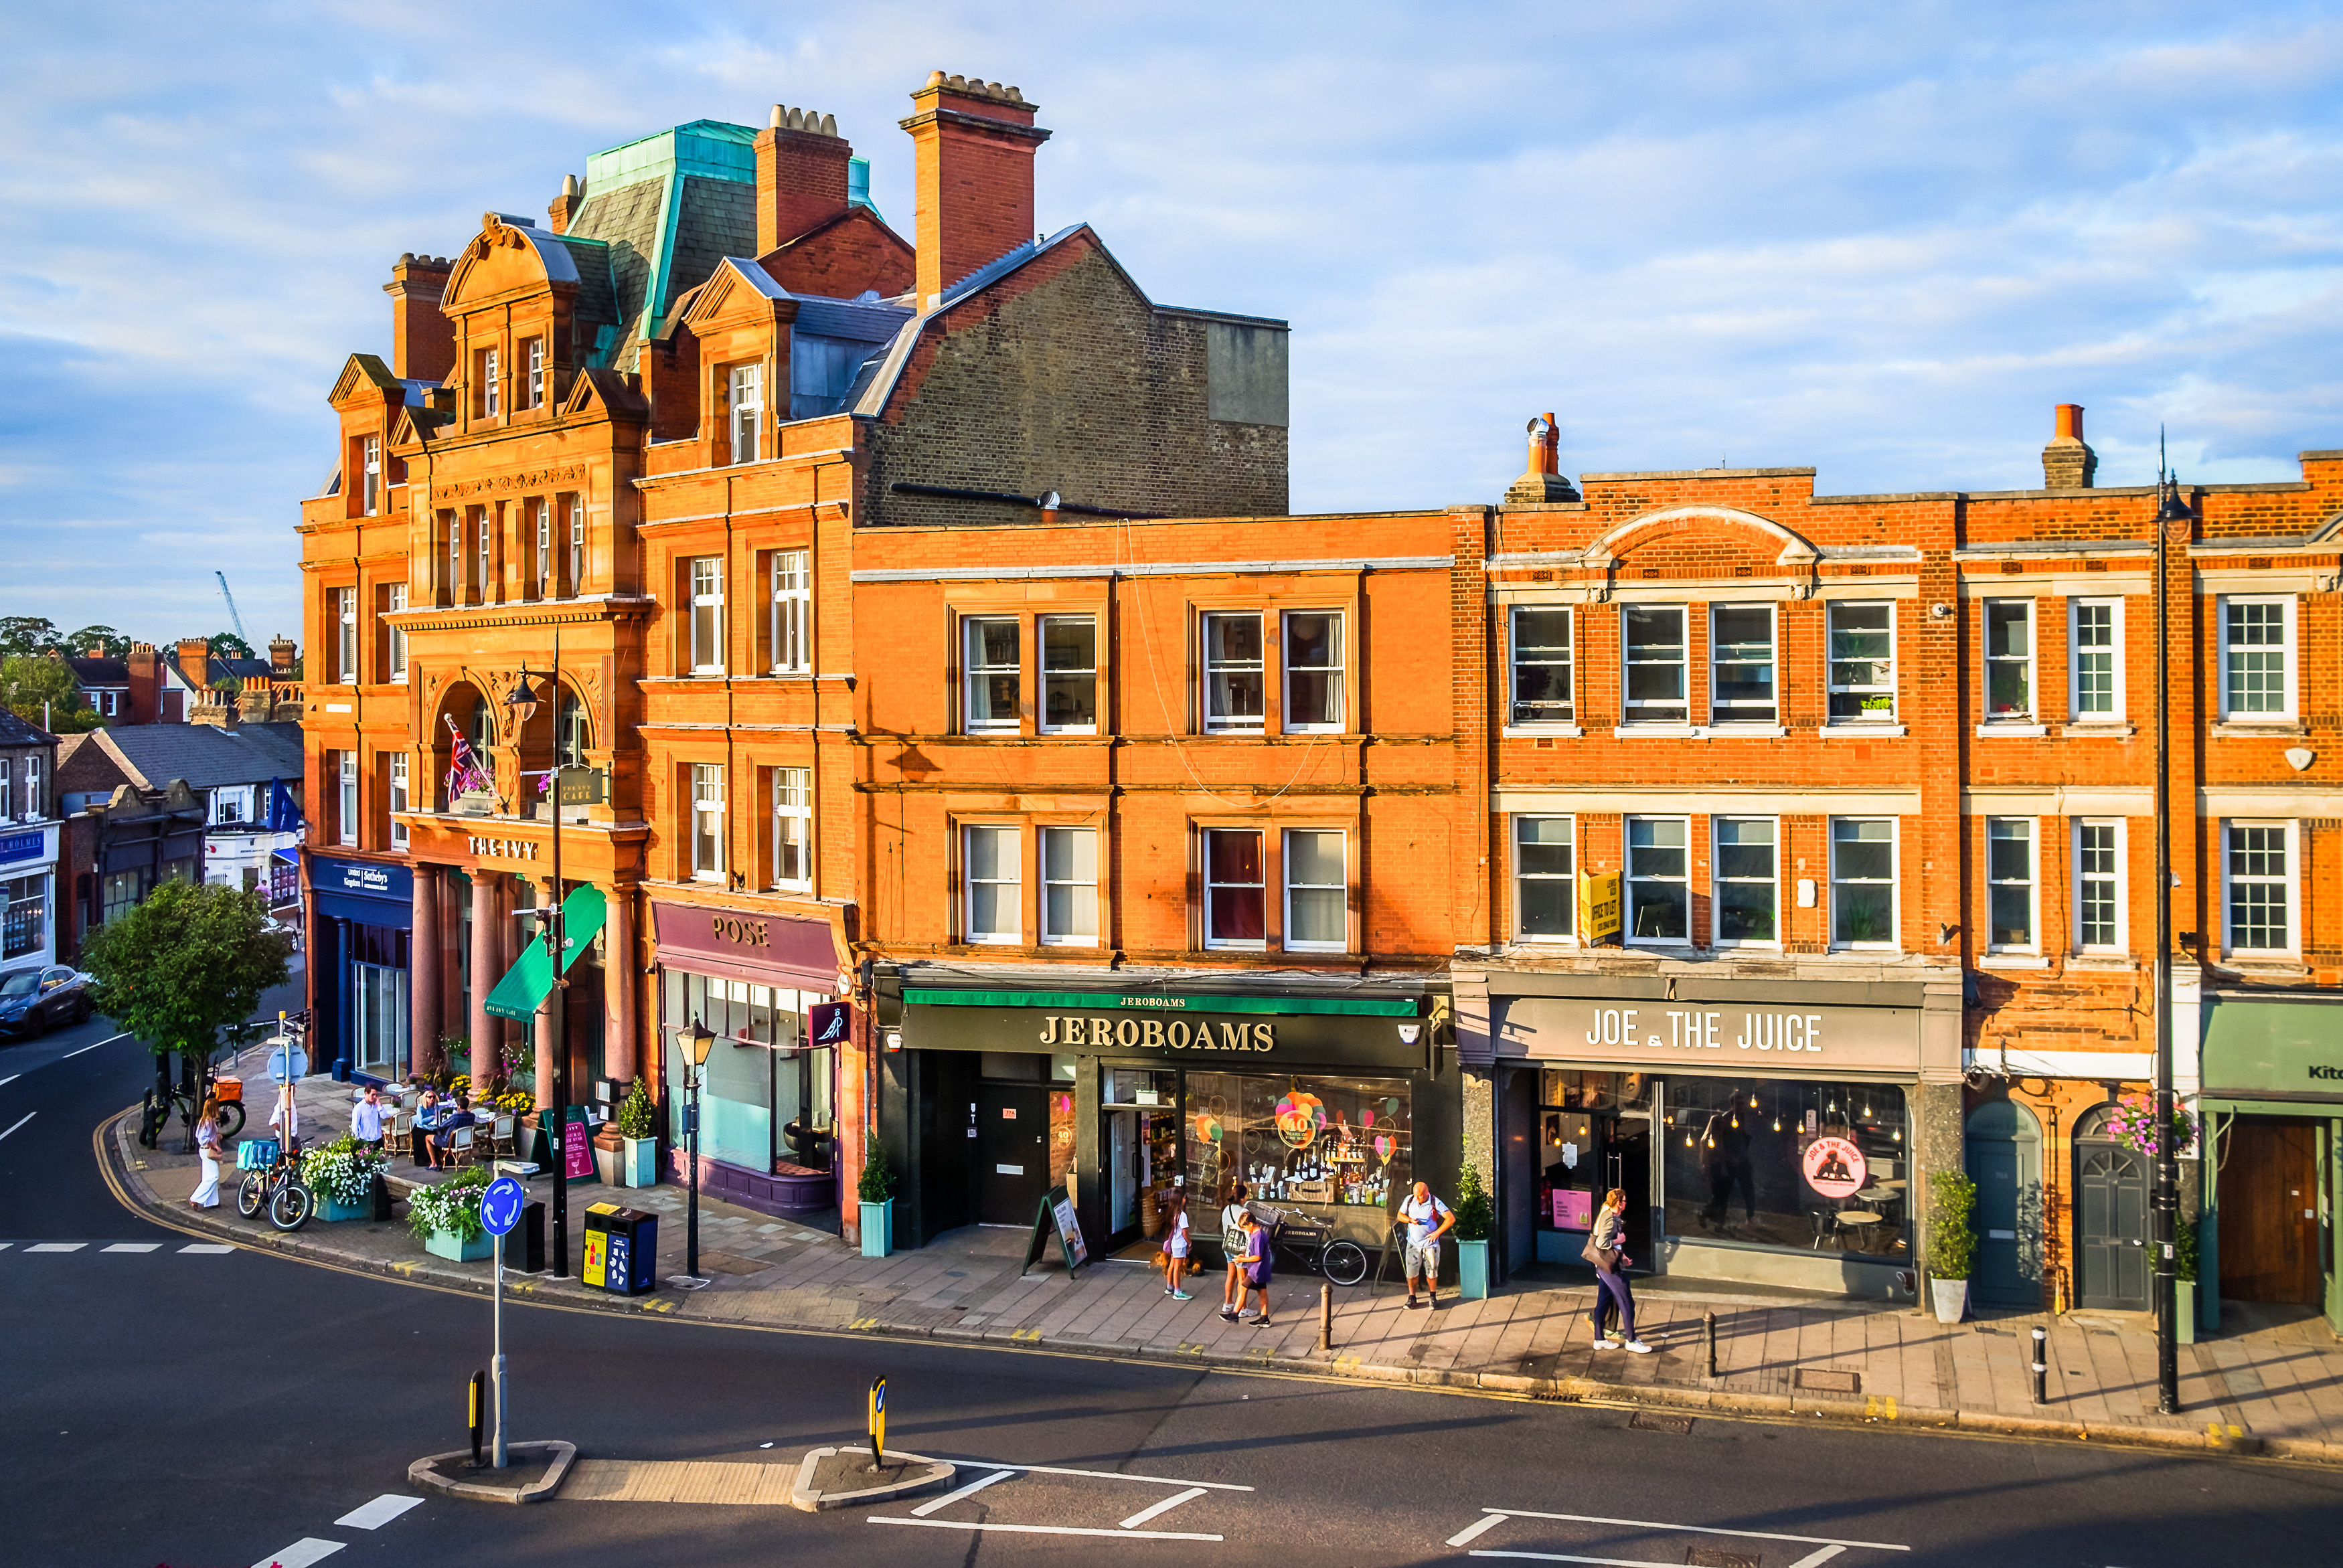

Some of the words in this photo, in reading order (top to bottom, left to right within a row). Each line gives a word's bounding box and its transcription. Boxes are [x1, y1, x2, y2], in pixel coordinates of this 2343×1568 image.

[9, 836, 41, 849] HOLMES
[468, 836, 499, 857] THE
[503, 840, 536, 861] IVY
[363, 871, 388, 885] Sotheby's
[1592, 903, 1603, 922] OFFICE
[1604, 901, 1609, 917] TO
[712, 916, 771, 948] POSE
[1120, 997, 1186, 1007] JEROBOAMS
[1040, 1016, 1274, 1052] JEROBOAMS
[1586, 1009, 1639, 1045] JOE
[1647, 1035, 1664, 1047] &
[1666, 1011, 1722, 1048] THE
[1737, 1013, 1823, 1052] JUICE
[1058, 1131, 1069, 1139] 40
[1286, 1118, 1308, 1132] 40
[1808, 1146, 1820, 1160] JOE
[1819, 1142, 1826, 1150] &
[1826, 1140, 1841, 1149] THE
[1842, 1145, 1860, 1163] JUICE
